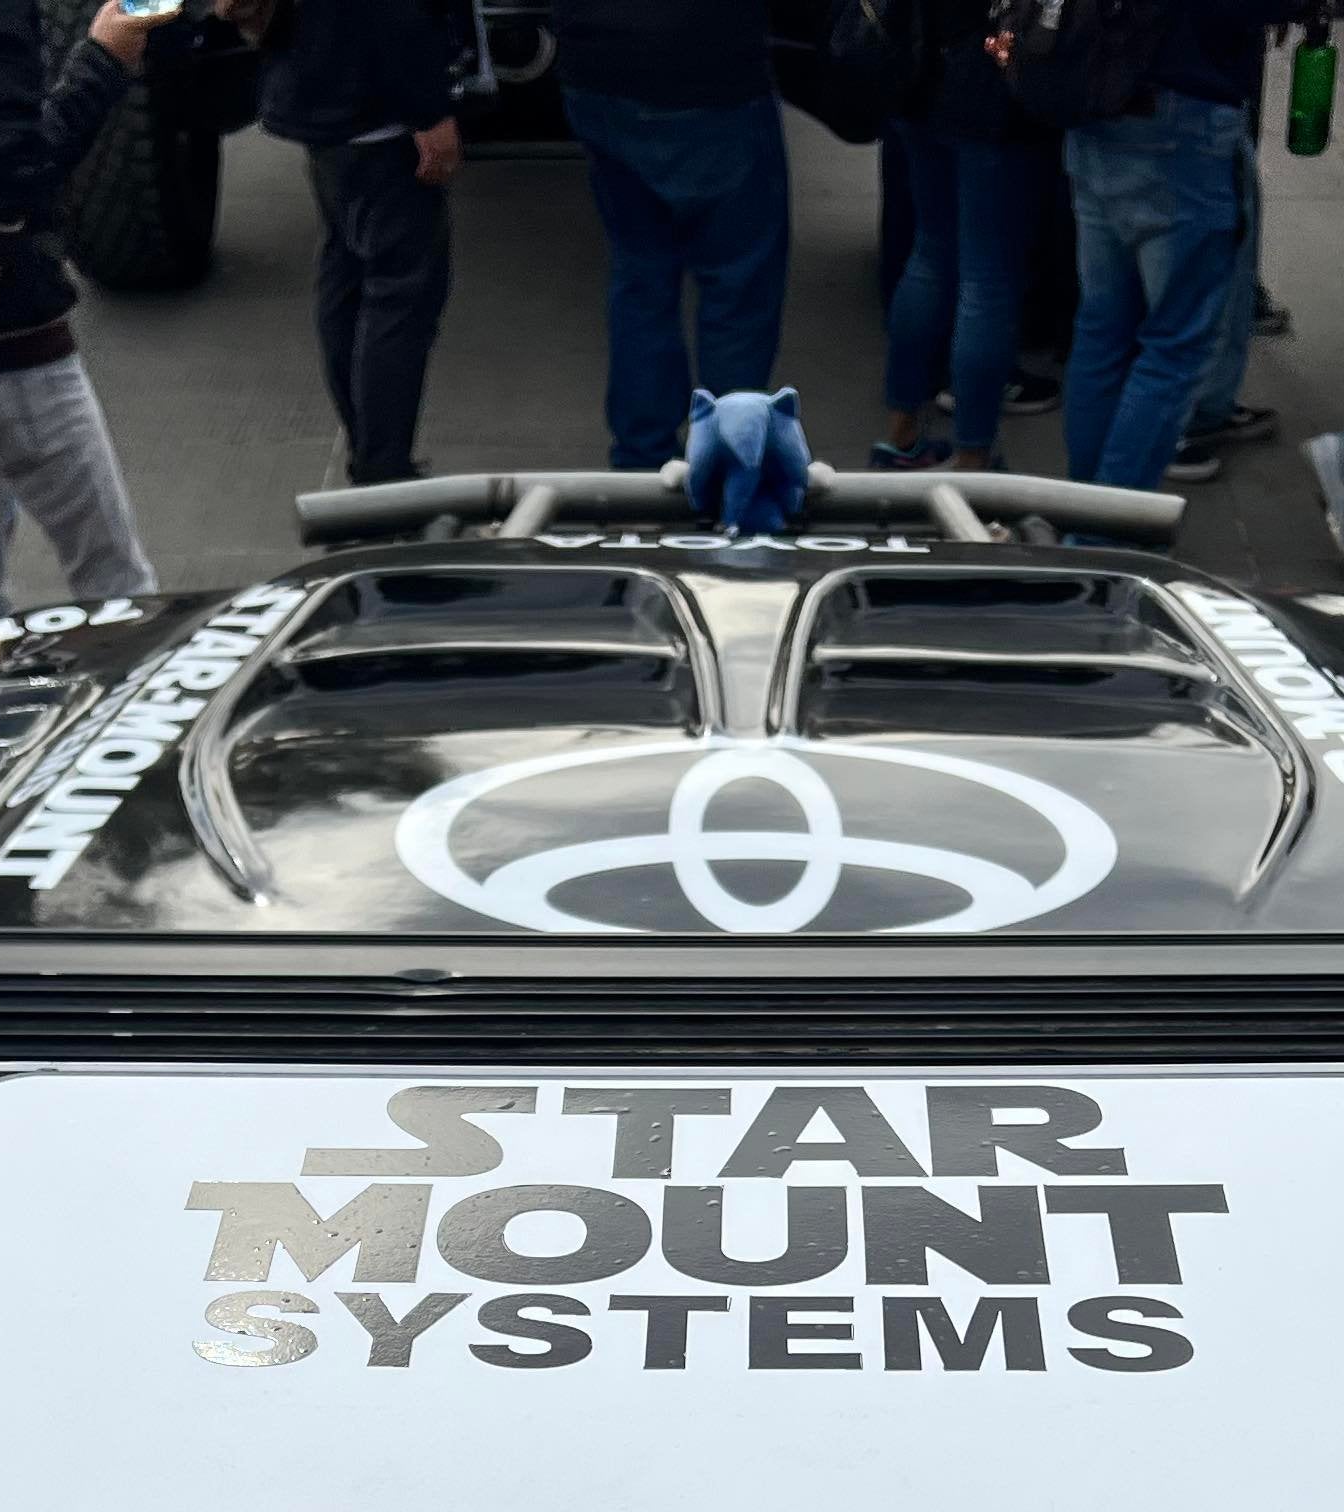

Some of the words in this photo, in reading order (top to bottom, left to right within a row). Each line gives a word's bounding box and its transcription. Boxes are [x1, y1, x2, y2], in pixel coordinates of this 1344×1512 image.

[533, 533, 931, 553] TOYOTA
[300, 1085, 1129, 1180] STAR
[184, 1181, 1231, 1287] MOUNT
[191, 1290, 1196, 1373] SYSTEMS
